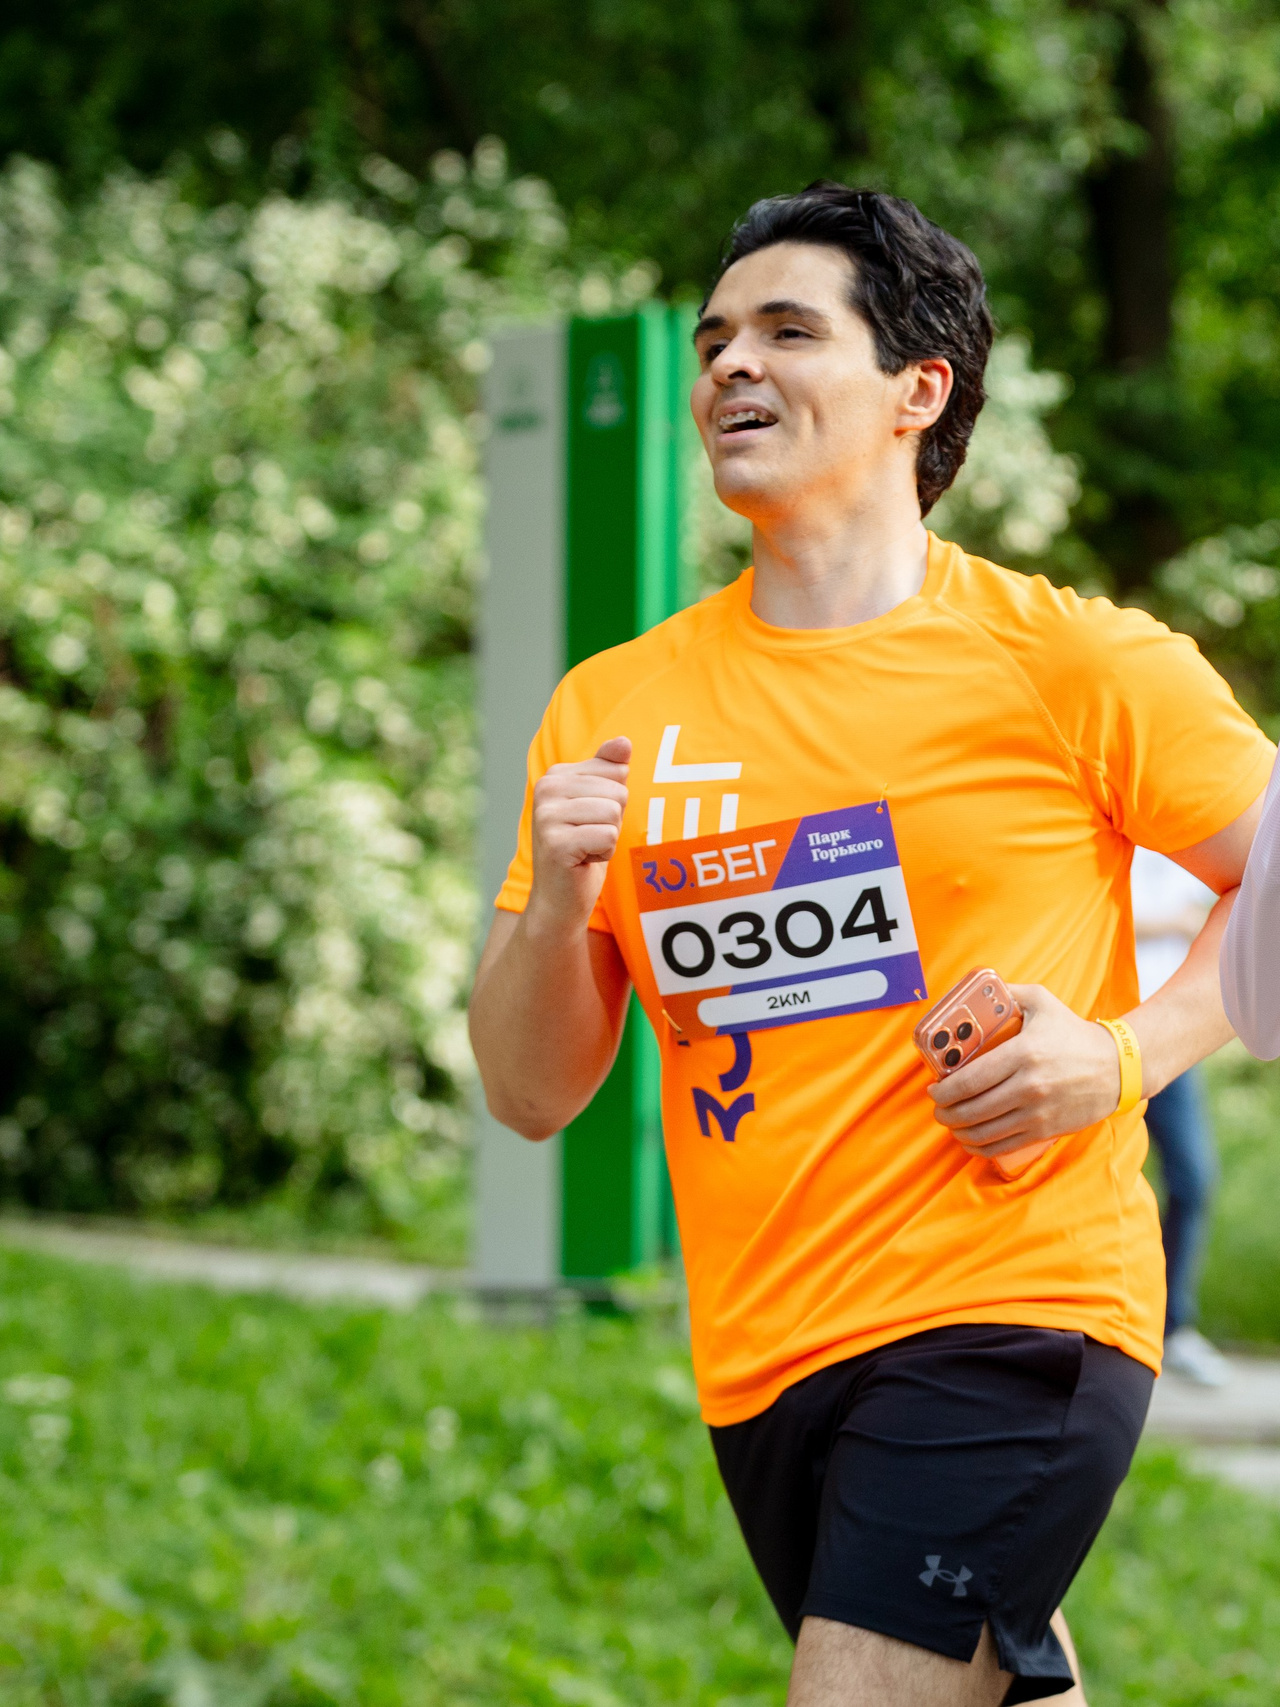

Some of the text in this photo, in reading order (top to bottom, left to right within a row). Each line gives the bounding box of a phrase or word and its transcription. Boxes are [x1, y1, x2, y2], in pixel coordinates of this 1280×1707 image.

[807, 829, 851, 847] Парк
[811, 839, 884, 863] Горького
[661, 886, 899, 978] 0304
